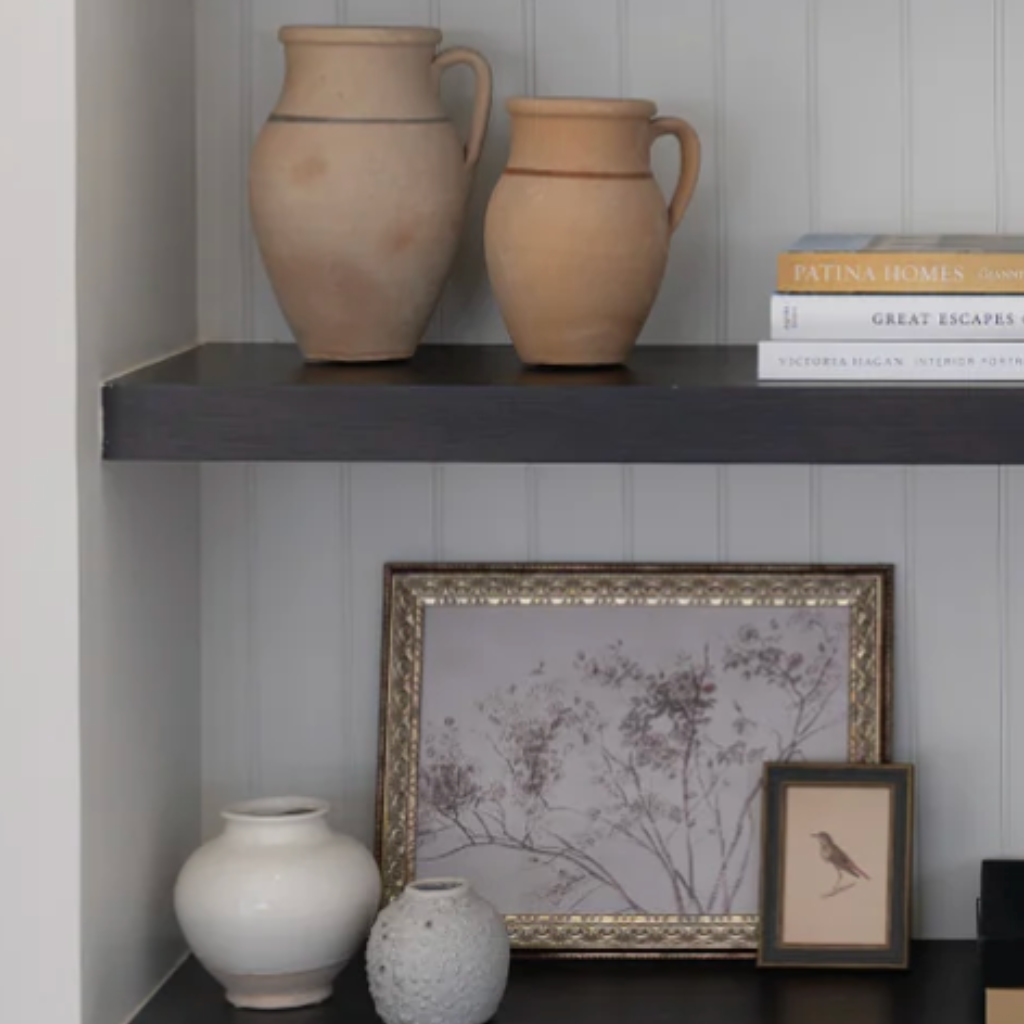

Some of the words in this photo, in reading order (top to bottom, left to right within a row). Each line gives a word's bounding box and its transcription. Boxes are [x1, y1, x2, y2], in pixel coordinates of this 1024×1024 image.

[793, 263, 876, 282] PATINA
[884, 263, 964, 282] HOMES
[871, 312, 930, 326] GREAT
[938, 312, 1015, 326] ESCAPES
[779, 357, 847, 367] VICTORIA
[851, 357, 903, 367] HAGAN
[914, 356, 975, 367] INTERIOR
